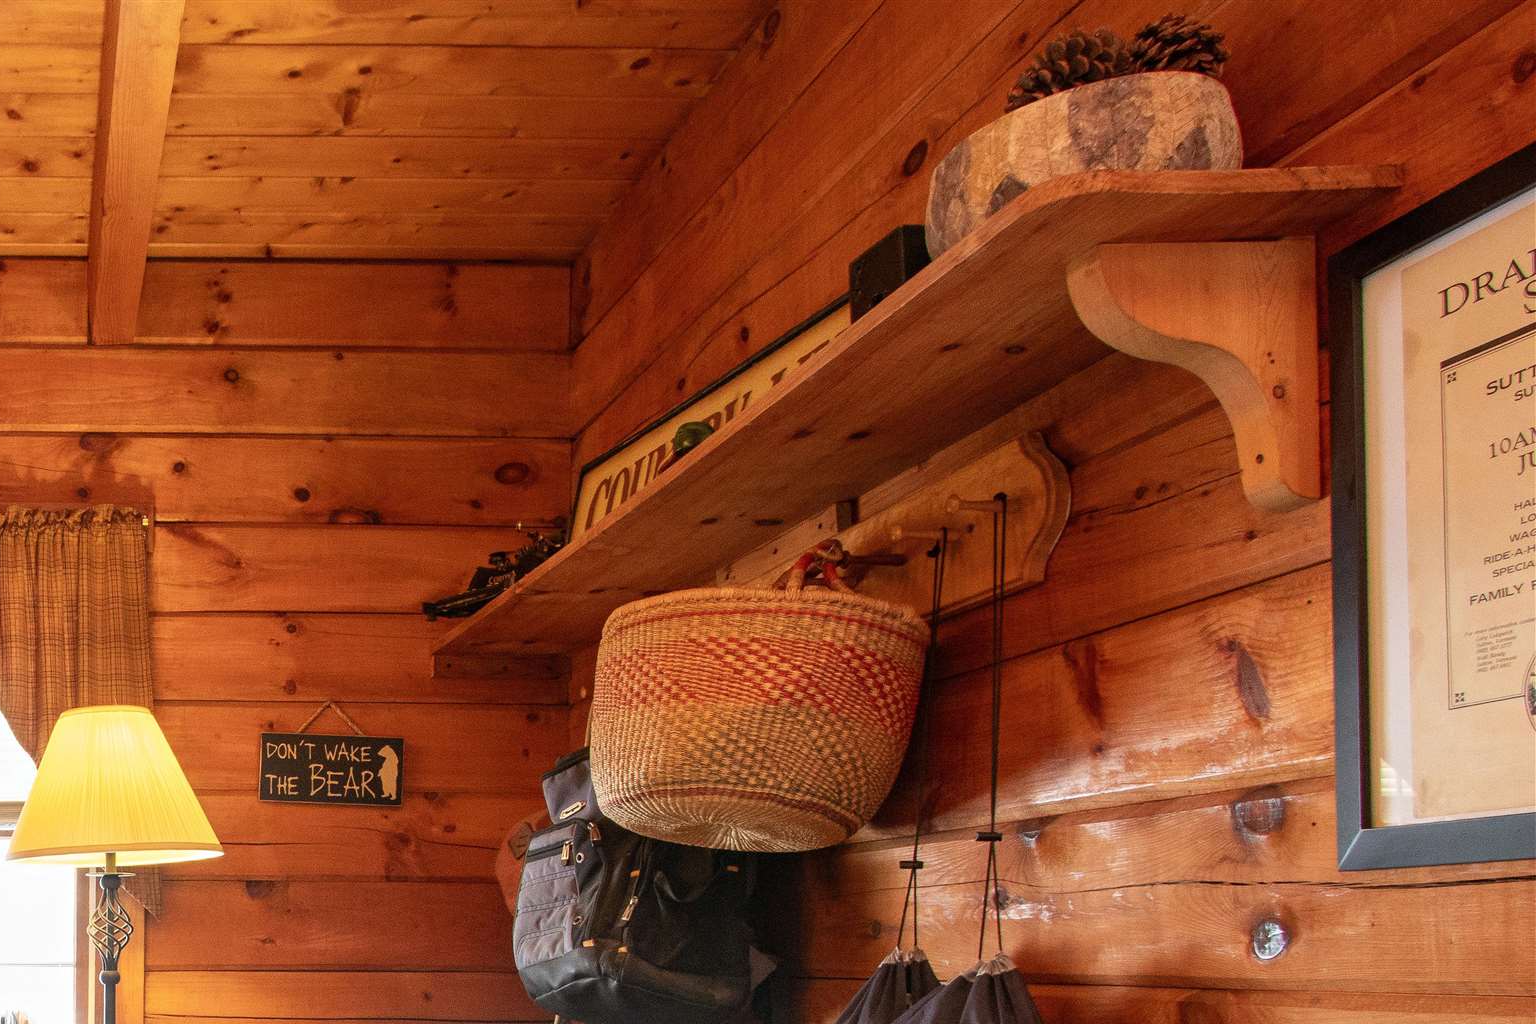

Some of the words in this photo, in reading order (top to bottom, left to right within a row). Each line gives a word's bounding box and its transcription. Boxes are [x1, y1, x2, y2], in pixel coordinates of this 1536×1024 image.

[1438, 248, 1536, 319] DRA
[1469, 583, 1524, 607] FAMILY
[266, 740, 316, 760] DON'T
[324, 742, 372, 762] WAKE
[264, 774, 299, 796] THE
[309, 763, 376, 799] BEAR
